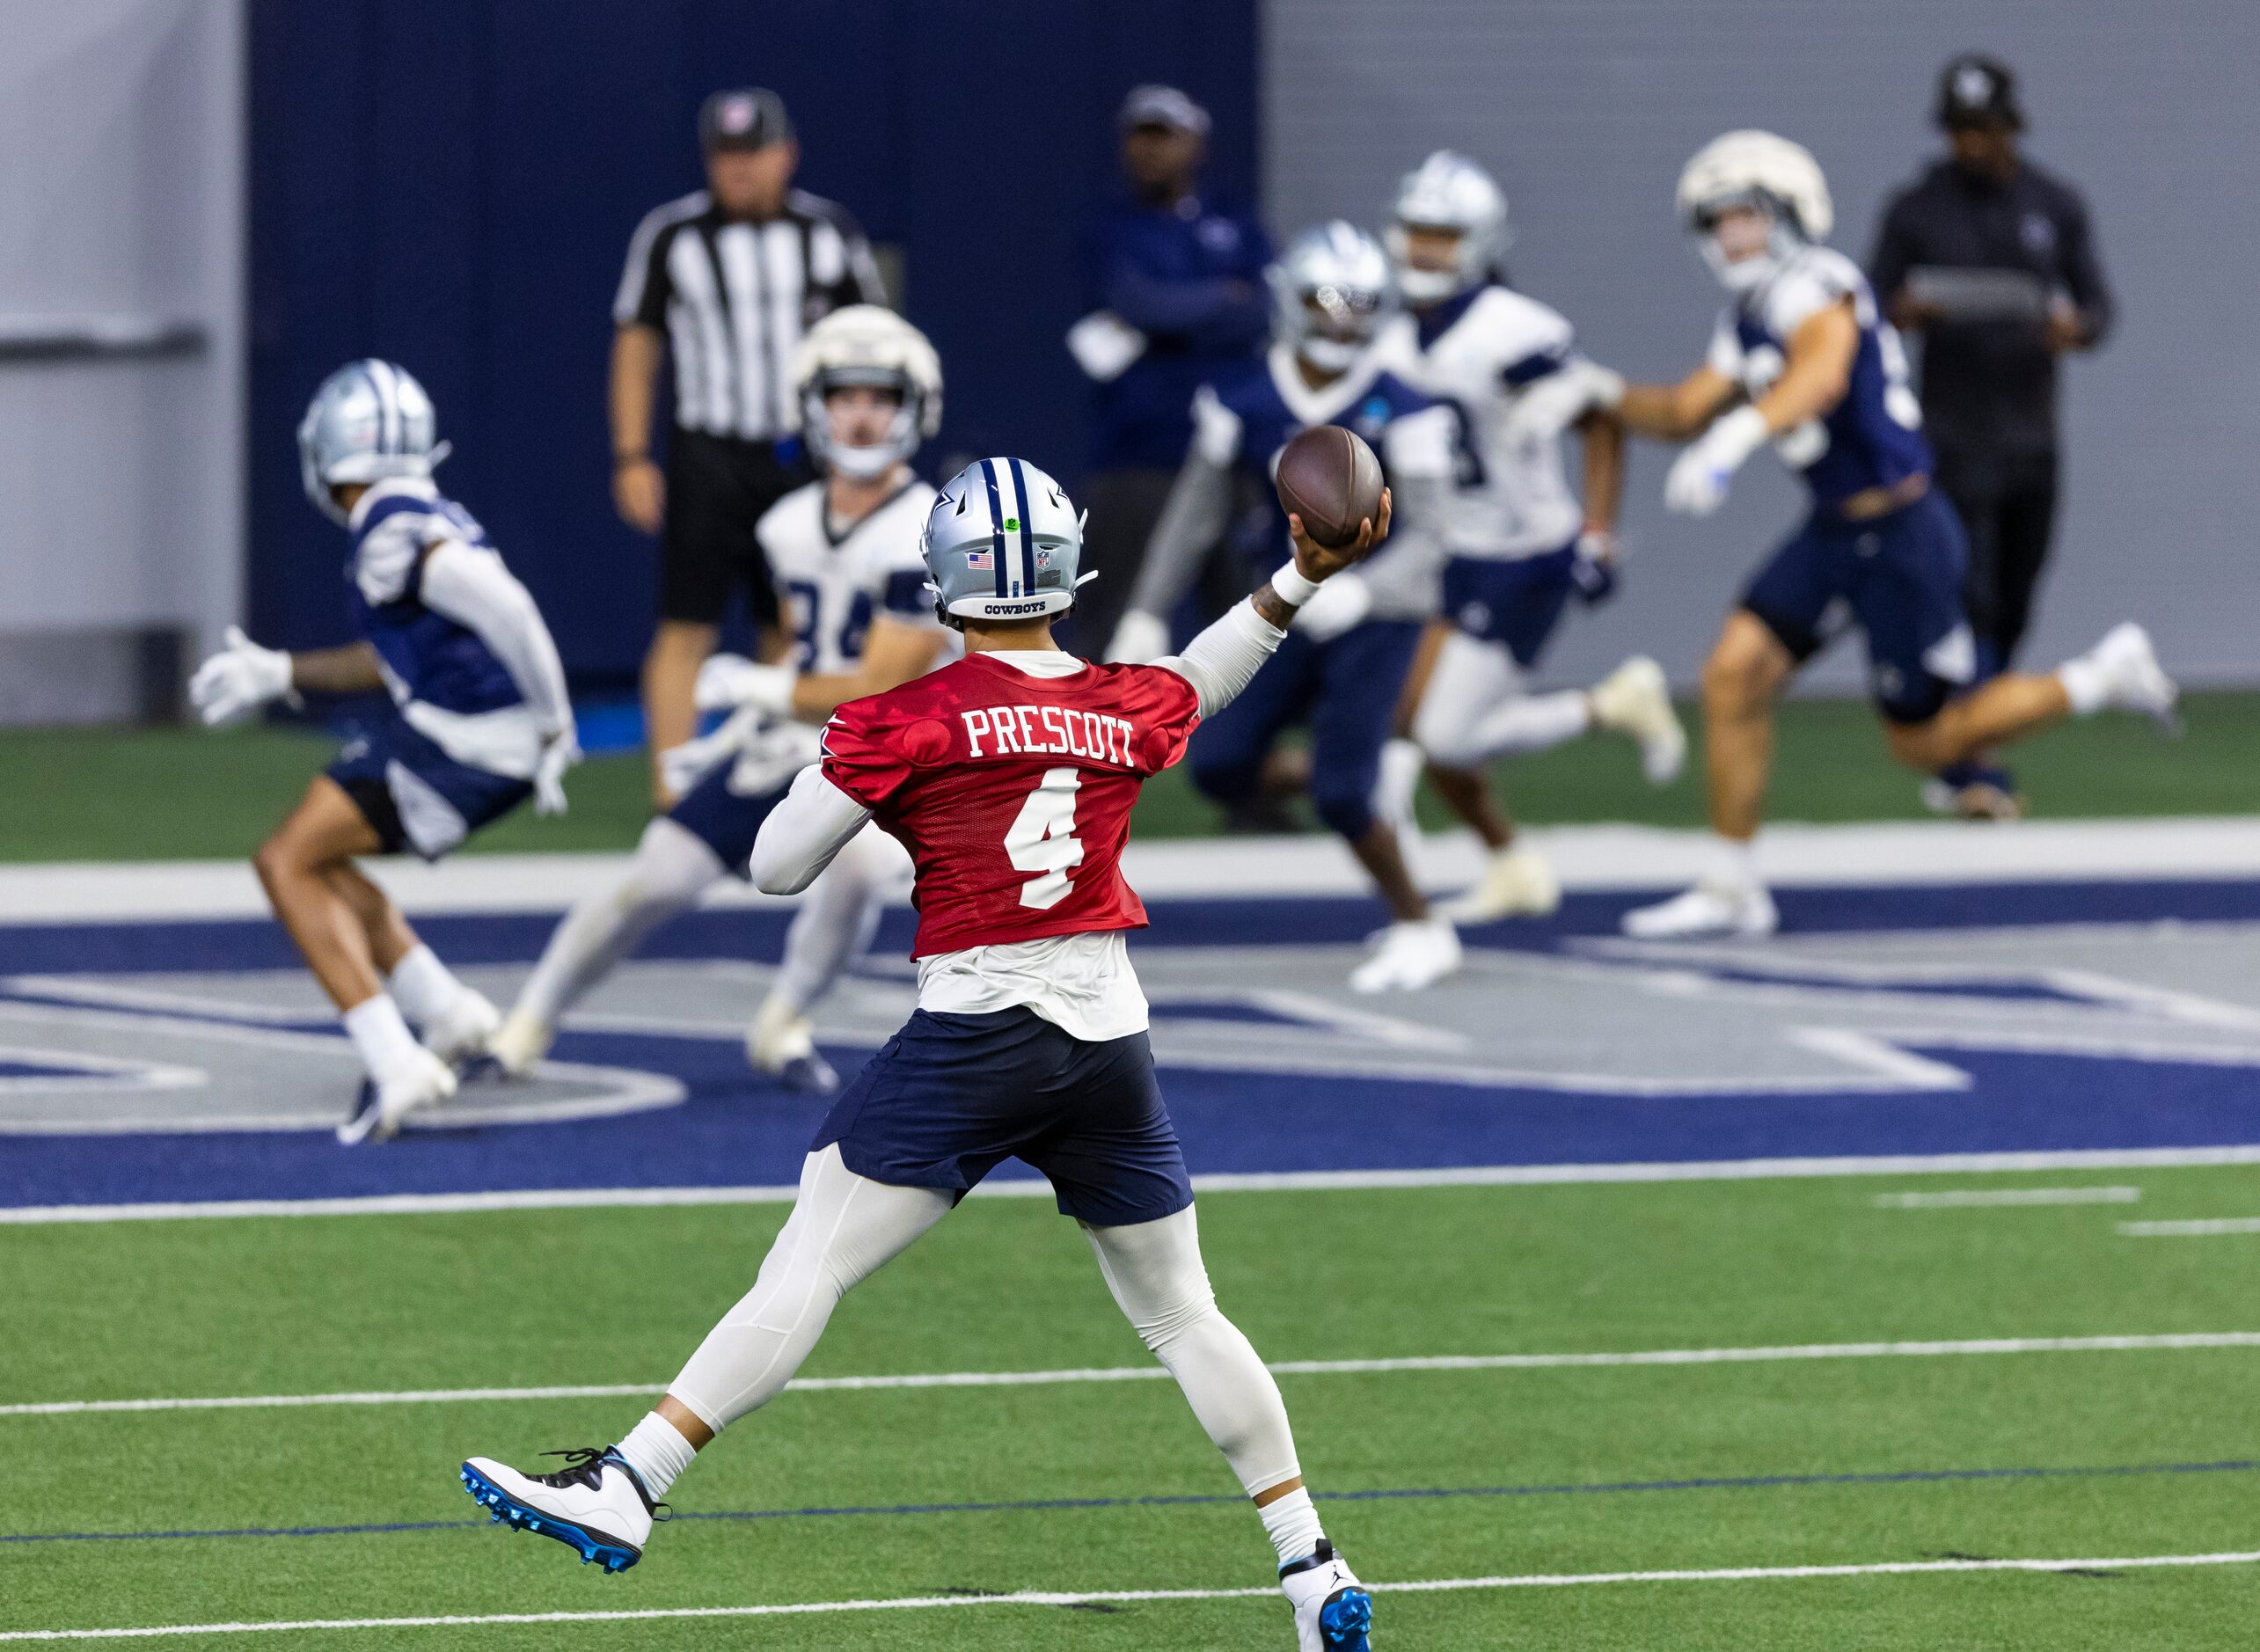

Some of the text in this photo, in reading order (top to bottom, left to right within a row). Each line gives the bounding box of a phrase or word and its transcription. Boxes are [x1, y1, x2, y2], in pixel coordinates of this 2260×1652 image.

[984, 601, 1046, 614] COWBOYS
[961, 705, 1135, 767] PRESCOTT
[1003, 767, 1085, 910] 4
